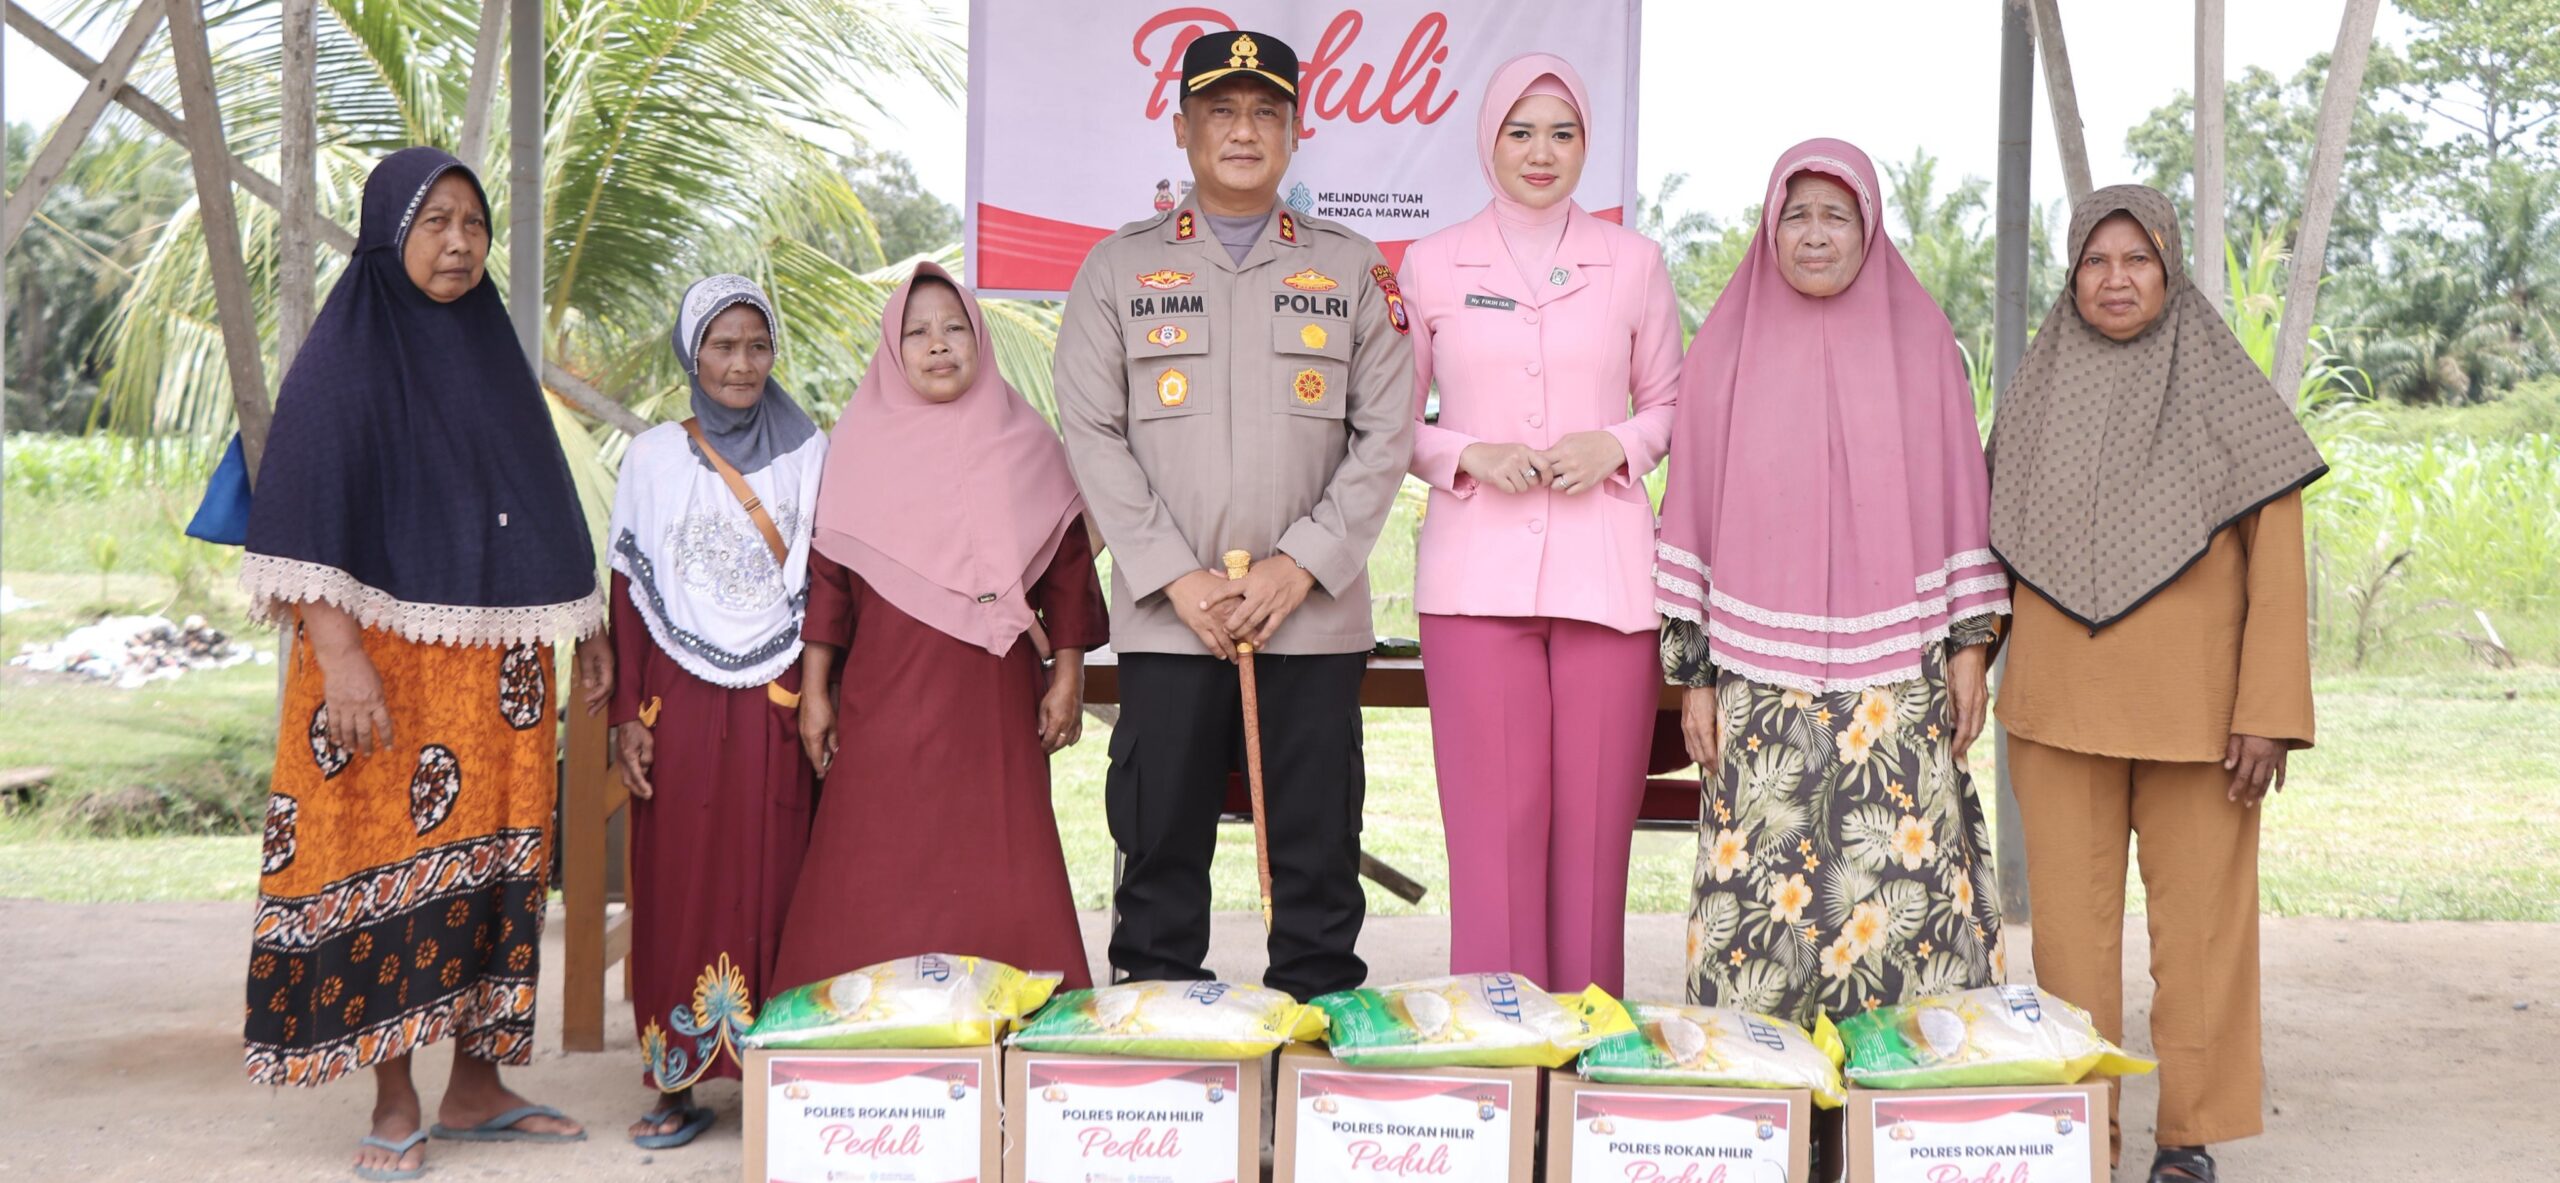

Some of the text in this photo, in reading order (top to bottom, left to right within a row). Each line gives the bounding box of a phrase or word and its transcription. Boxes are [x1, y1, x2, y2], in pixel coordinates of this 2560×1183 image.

[1133, 7, 1458, 139] Pduli
[1318, 192, 1423, 204] MELINDUNGI TUAH
[1318, 207, 1430, 218] MENJAGA MARWAH
[1131, 295, 1203, 317] ISA IMAM
[1274, 294, 1347, 318] POLRI
[803, 1106, 946, 1120] POLRES ROKAN HILIR
[1062, 1109, 1204, 1122] POLRES ROKAN HILIR
[1332, 1121, 1475, 1140] POLRES ROKAN HILIR
[819, 1123, 925, 1159] Peduli
[1077, 1126, 1183, 1162] Peduli
[1609, 1142, 1753, 1159] POLRES ROKAN HILIR
[1347, 1140, 1452, 1177] Peduli
[1910, 1144, 2054, 1158] POLRES ROKAN HILIR
